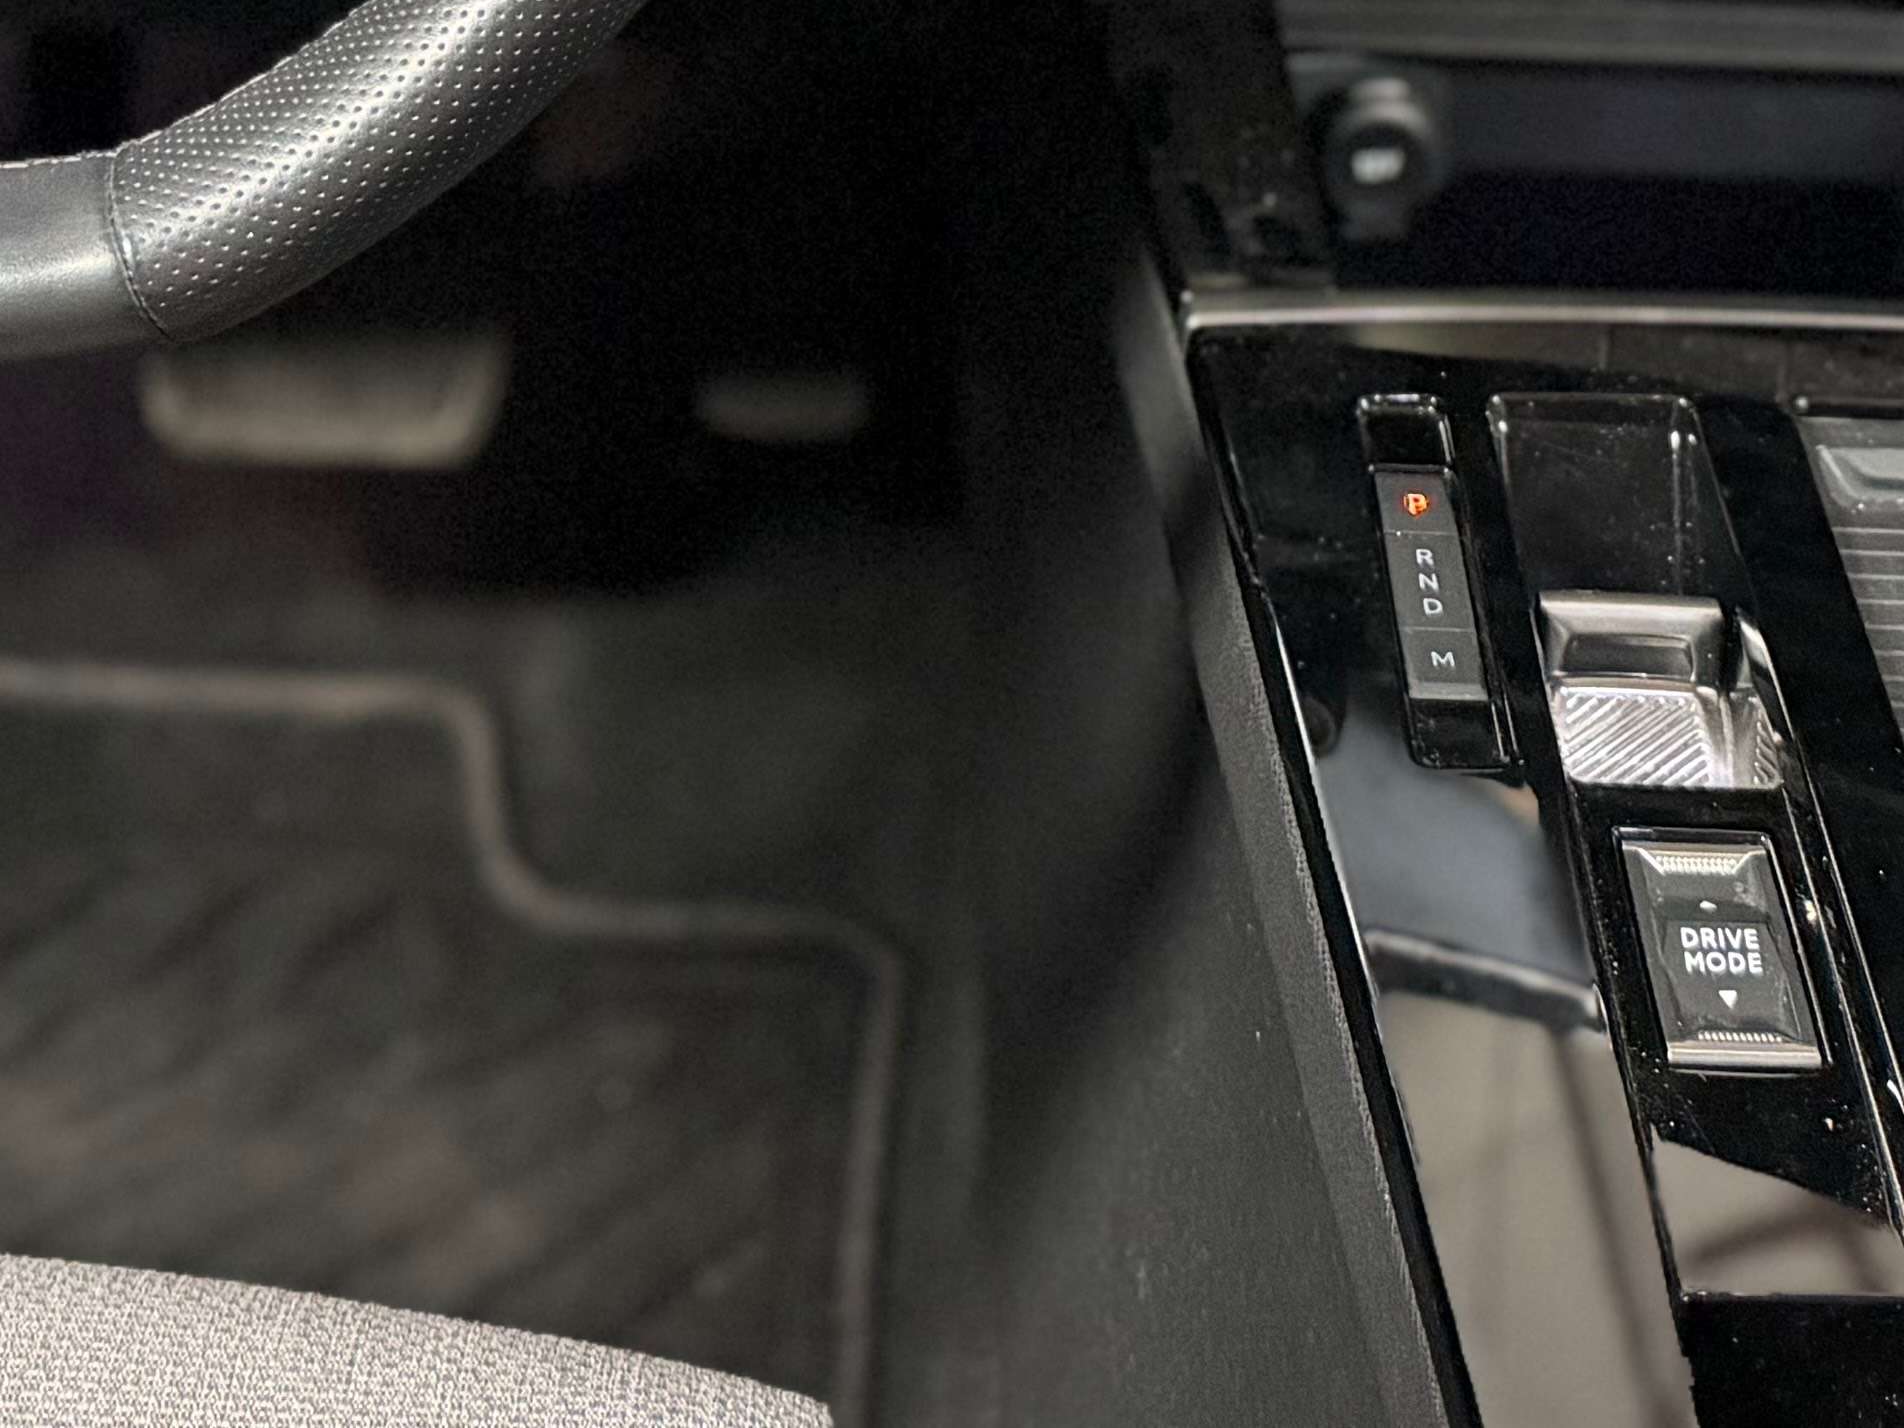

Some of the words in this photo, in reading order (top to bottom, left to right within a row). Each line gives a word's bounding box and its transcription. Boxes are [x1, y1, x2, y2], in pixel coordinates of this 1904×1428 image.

[1407, 493, 1429, 516] P
[1415, 548, 1434, 566] R
[1418, 573, 1440, 592] N
[1423, 598, 1443, 616] D
[1430, 650, 1457, 668] M
[1680, 926, 1760, 949] DRIVE
[1684, 951, 1764, 976] MODE
